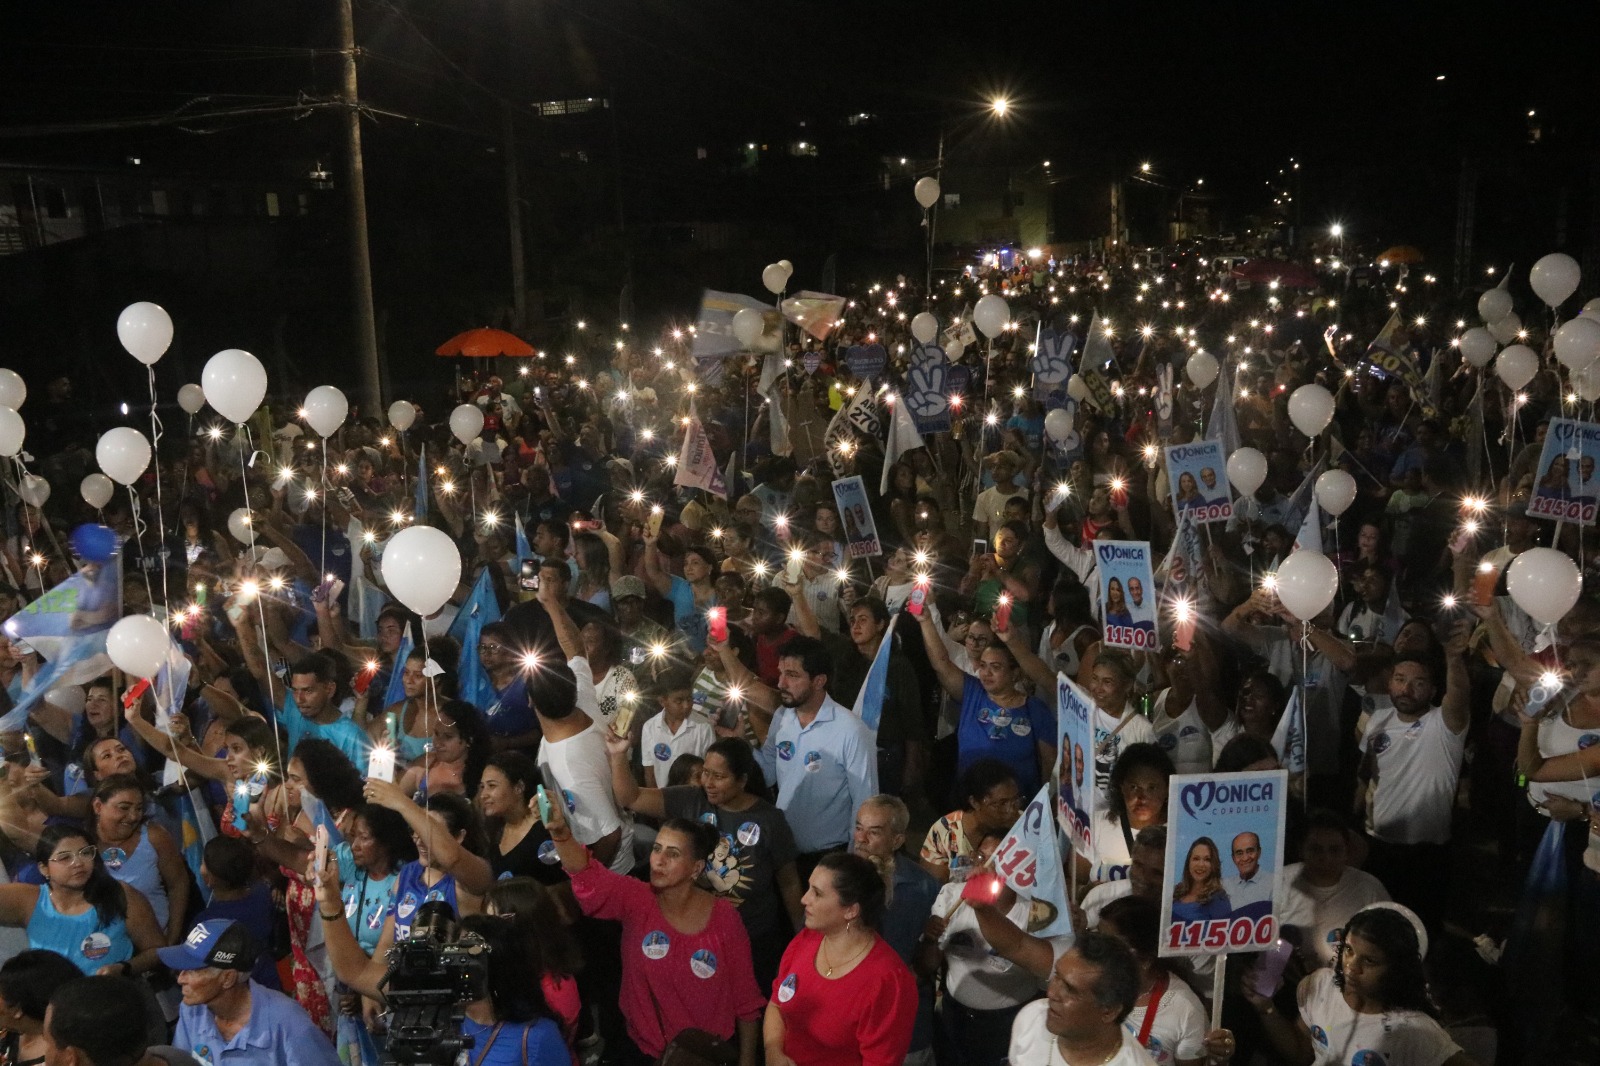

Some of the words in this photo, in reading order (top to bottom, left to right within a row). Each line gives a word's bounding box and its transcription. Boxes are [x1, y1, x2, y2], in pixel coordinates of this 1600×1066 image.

[1106, 626, 1157, 649] 11500
[1181, 781, 1273, 820] MÔNICA
[1212, 805, 1269, 816] CORDEIRO
[1169, 916, 1277, 948] 11500
[213, 950, 237, 960] RMF
